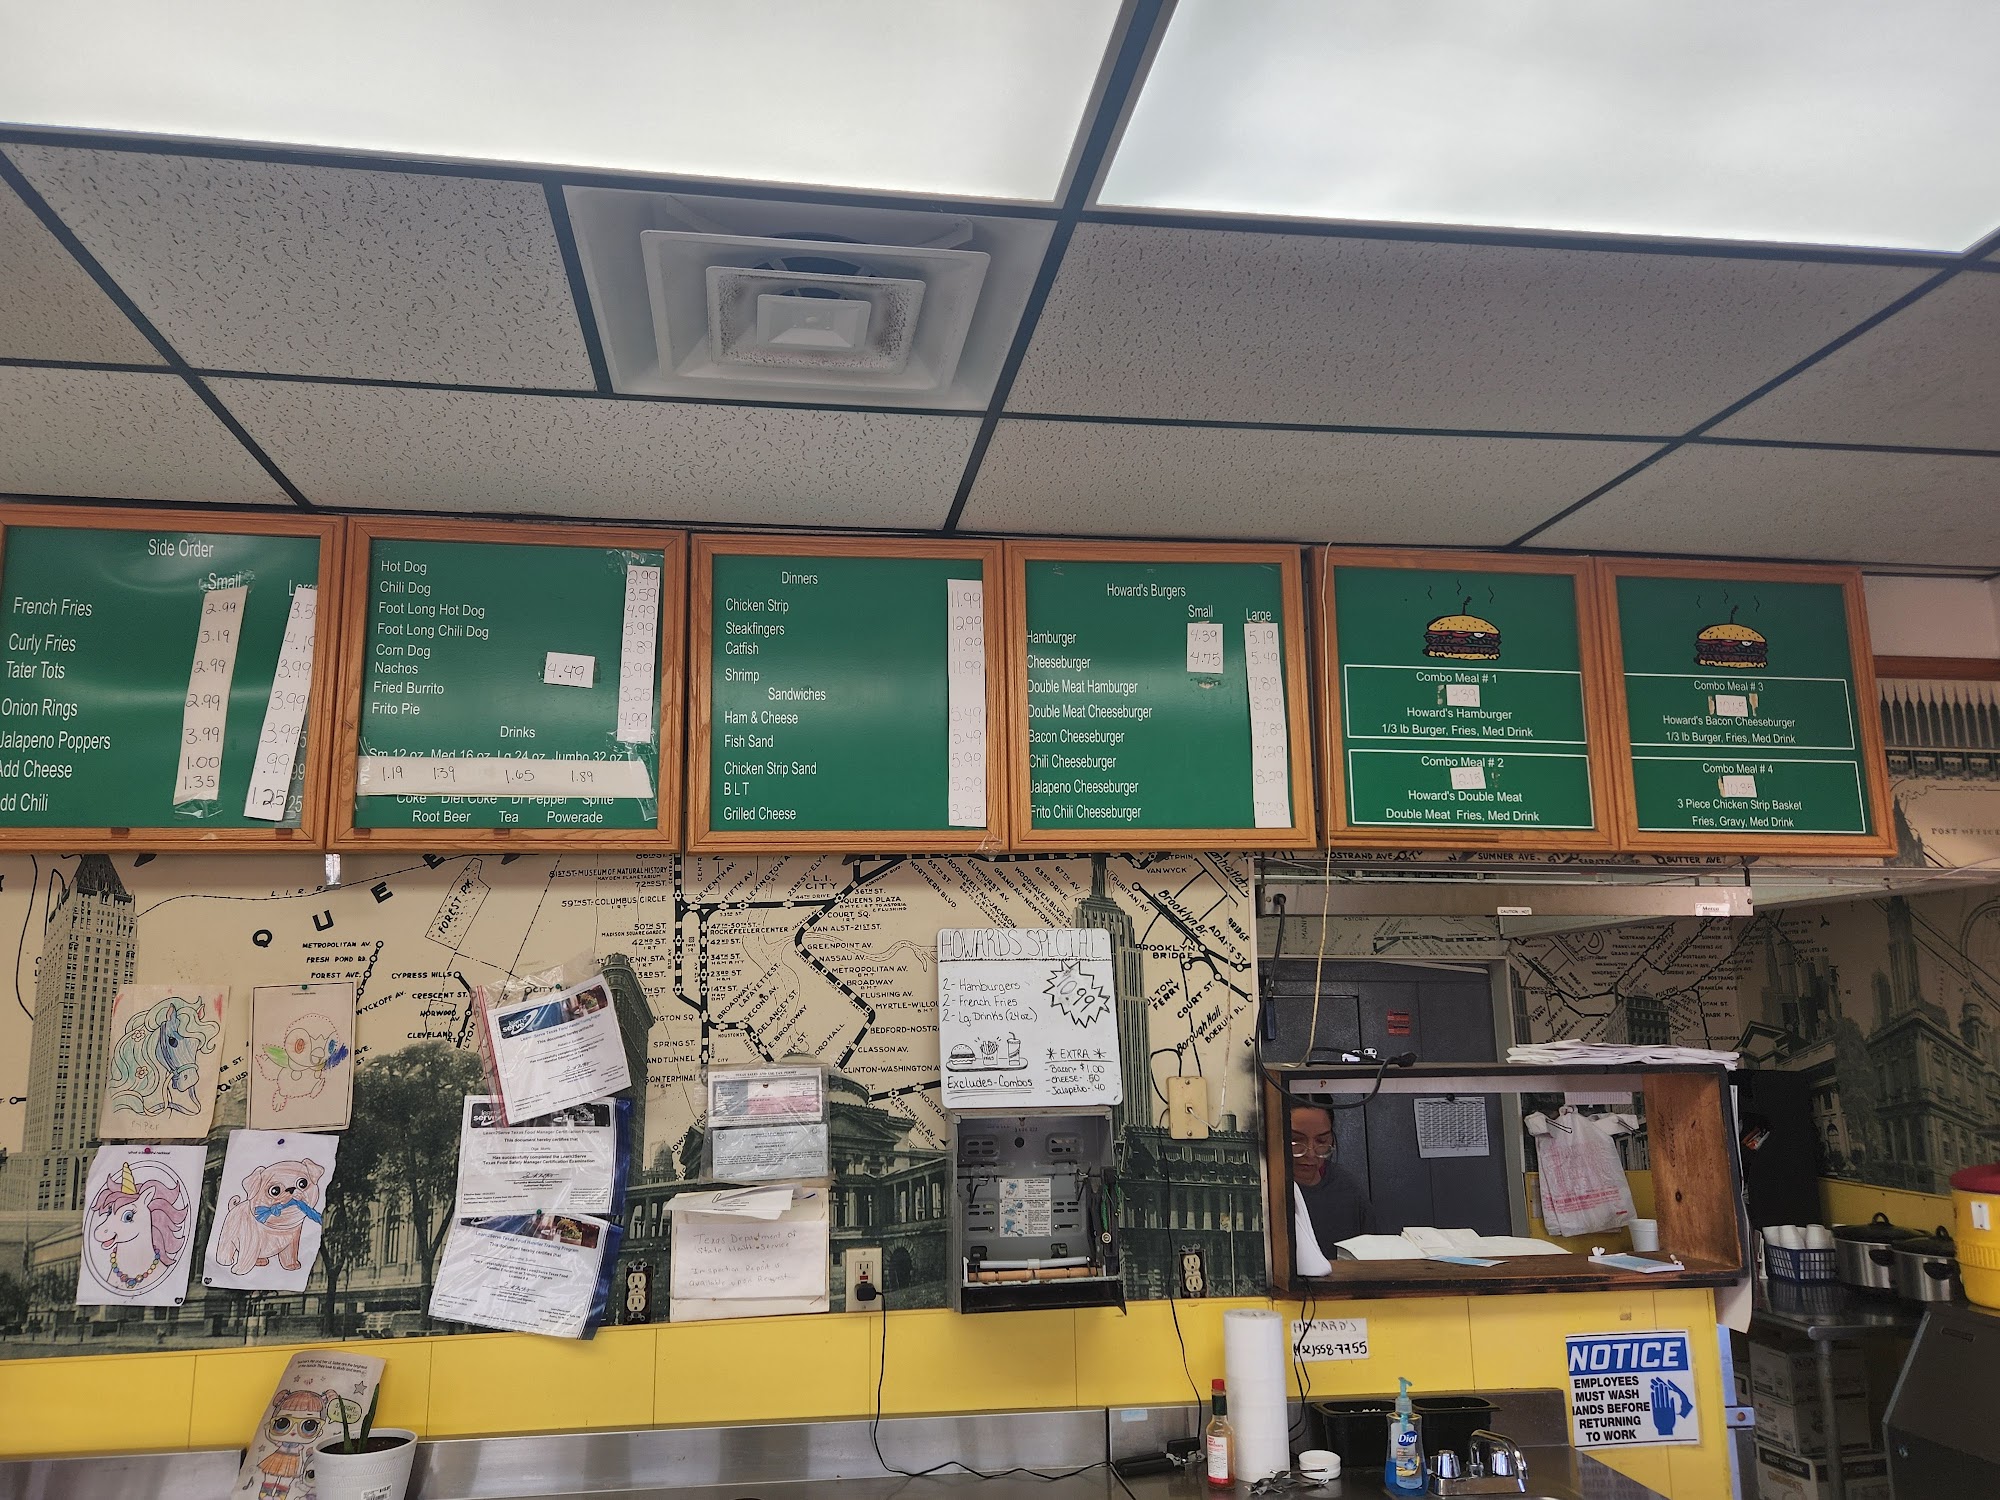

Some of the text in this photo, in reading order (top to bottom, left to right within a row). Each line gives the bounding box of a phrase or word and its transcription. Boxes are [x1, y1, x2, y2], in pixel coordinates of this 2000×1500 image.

[148, 539, 213, 558] Side Order
[381, 560, 427, 575] Hot Dog
[208, 574, 241, 589] Small
[782, 572, 818, 585] Dinners
[380, 582, 431, 596] Chili Dog
[1107, 583, 1186, 600] Howard's Burgers
[13, 597, 92, 616] French Fries
[206, 603, 236, 614] 2.99
[379, 602, 485, 619] Foot Long Hot Dog
[726, 598, 789, 615] Chicken Strip
[1188, 605, 1213, 618] Small
[726, 621, 784, 637] Steakfingers
[201, 630, 229, 643] 3.19
[1190, 630, 1217, 643] 4.39
[8, 634, 76, 655] Curly Fries
[376, 644, 431, 659] Corn Dog
[725, 641, 759, 655] Catfish
[1027, 655, 1090, 672] Cheeseburger
[1190, 652, 1221, 666] 4.75
[6, 661, 65, 679] Tater Tots
[194, 660, 226, 673] 2.99
[375, 662, 418, 675] Nachos
[547, 664, 584, 679] 4.49
[725, 668, 759, 684] Shrimp
[1416, 672, 1497, 683] Combo Meal # 1
[374, 682, 444, 695] Fried Burrito
[768, 687, 826, 701] Sandwiches
[1027, 680, 1137, 696] Double Meat Hamburger
[1, 698, 77, 720] Onion Rings
[186, 694, 220, 710] 2.99
[372, 703, 420, 715] Frito Pie
[724, 711, 798, 725] Ham & Cheese
[1407, 708, 1512, 721] Howard's Hamburger
[1663, 715, 1795, 730] Howard's Bacon Cheeseburger
[186, 727, 219, 744] 3.99
[500, 726, 535, 738] Drinks
[1382, 724, 1533, 737] 1/3 lb Burger, Fries, Med Drink
[0, 731, 111, 753] Jalapeno Poppers
[724, 735, 773, 748] Fish Sand
[1029, 730, 1124, 746] Bacon Cheeseburger
[23, 760, 72, 778] Cheese
[187, 756, 219, 768] 1.00
[1029, 754, 1116, 771] Chili Cheeseburger
[382, 766, 593, 783] 1.19 1.65 1.89
[184, 776, 215, 790] 1.35
[1678, 799, 1802, 812] 3 Piece Chicken Strip Basket
[412, 811, 603, 823] Root Beer Tea Powerade
[724, 807, 796, 820] Grilled Cheese
[941, 929, 1100, 958] HOWARDS SPECIAL
[975, 1011, 1003, 1020] Drinks
[1061, 1050, 1090, 1059] EXTRA
[1569, 1342, 1681, 1371] NOTICE
[1574, 1376, 1639, 1388] EMPLOYEES
[1576, 1390, 1639, 1402] MUST WASH
[1608, 1402, 1650, 1413] BEFORE
[1580, 1416, 1641, 1429] RETURNING
[1398, 1434, 1417, 1442] Dial
[1586, 1430, 1636, 1442] TO WORK
